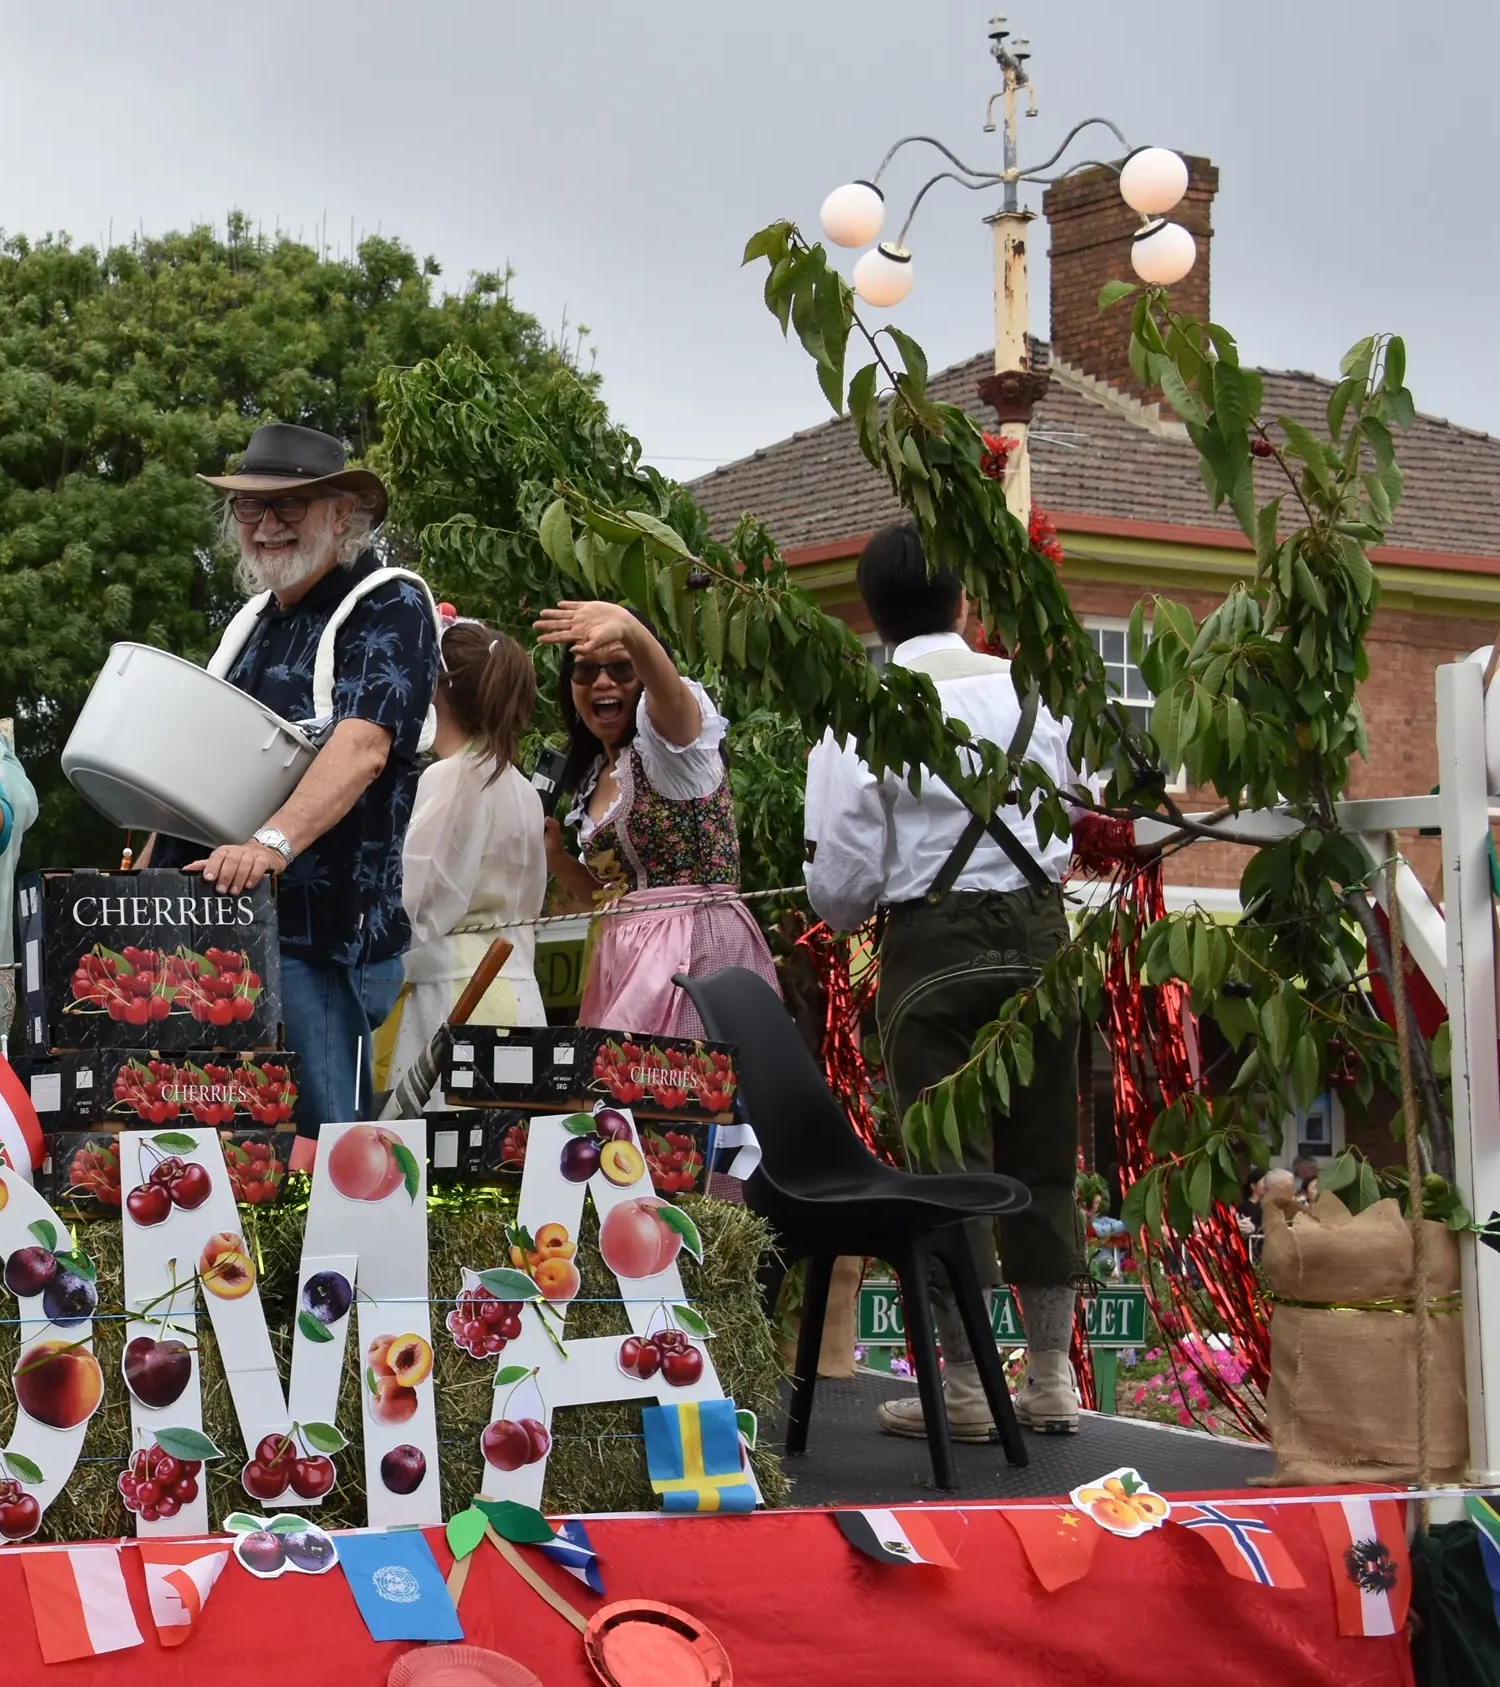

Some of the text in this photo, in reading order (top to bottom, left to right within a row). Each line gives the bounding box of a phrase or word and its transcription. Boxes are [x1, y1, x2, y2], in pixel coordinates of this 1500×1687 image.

[72, 896, 254, 927] CHERRIES
[630, 1066, 699, 1088] CHERRIES
[162, 1084, 246, 1102] CHERRIES
